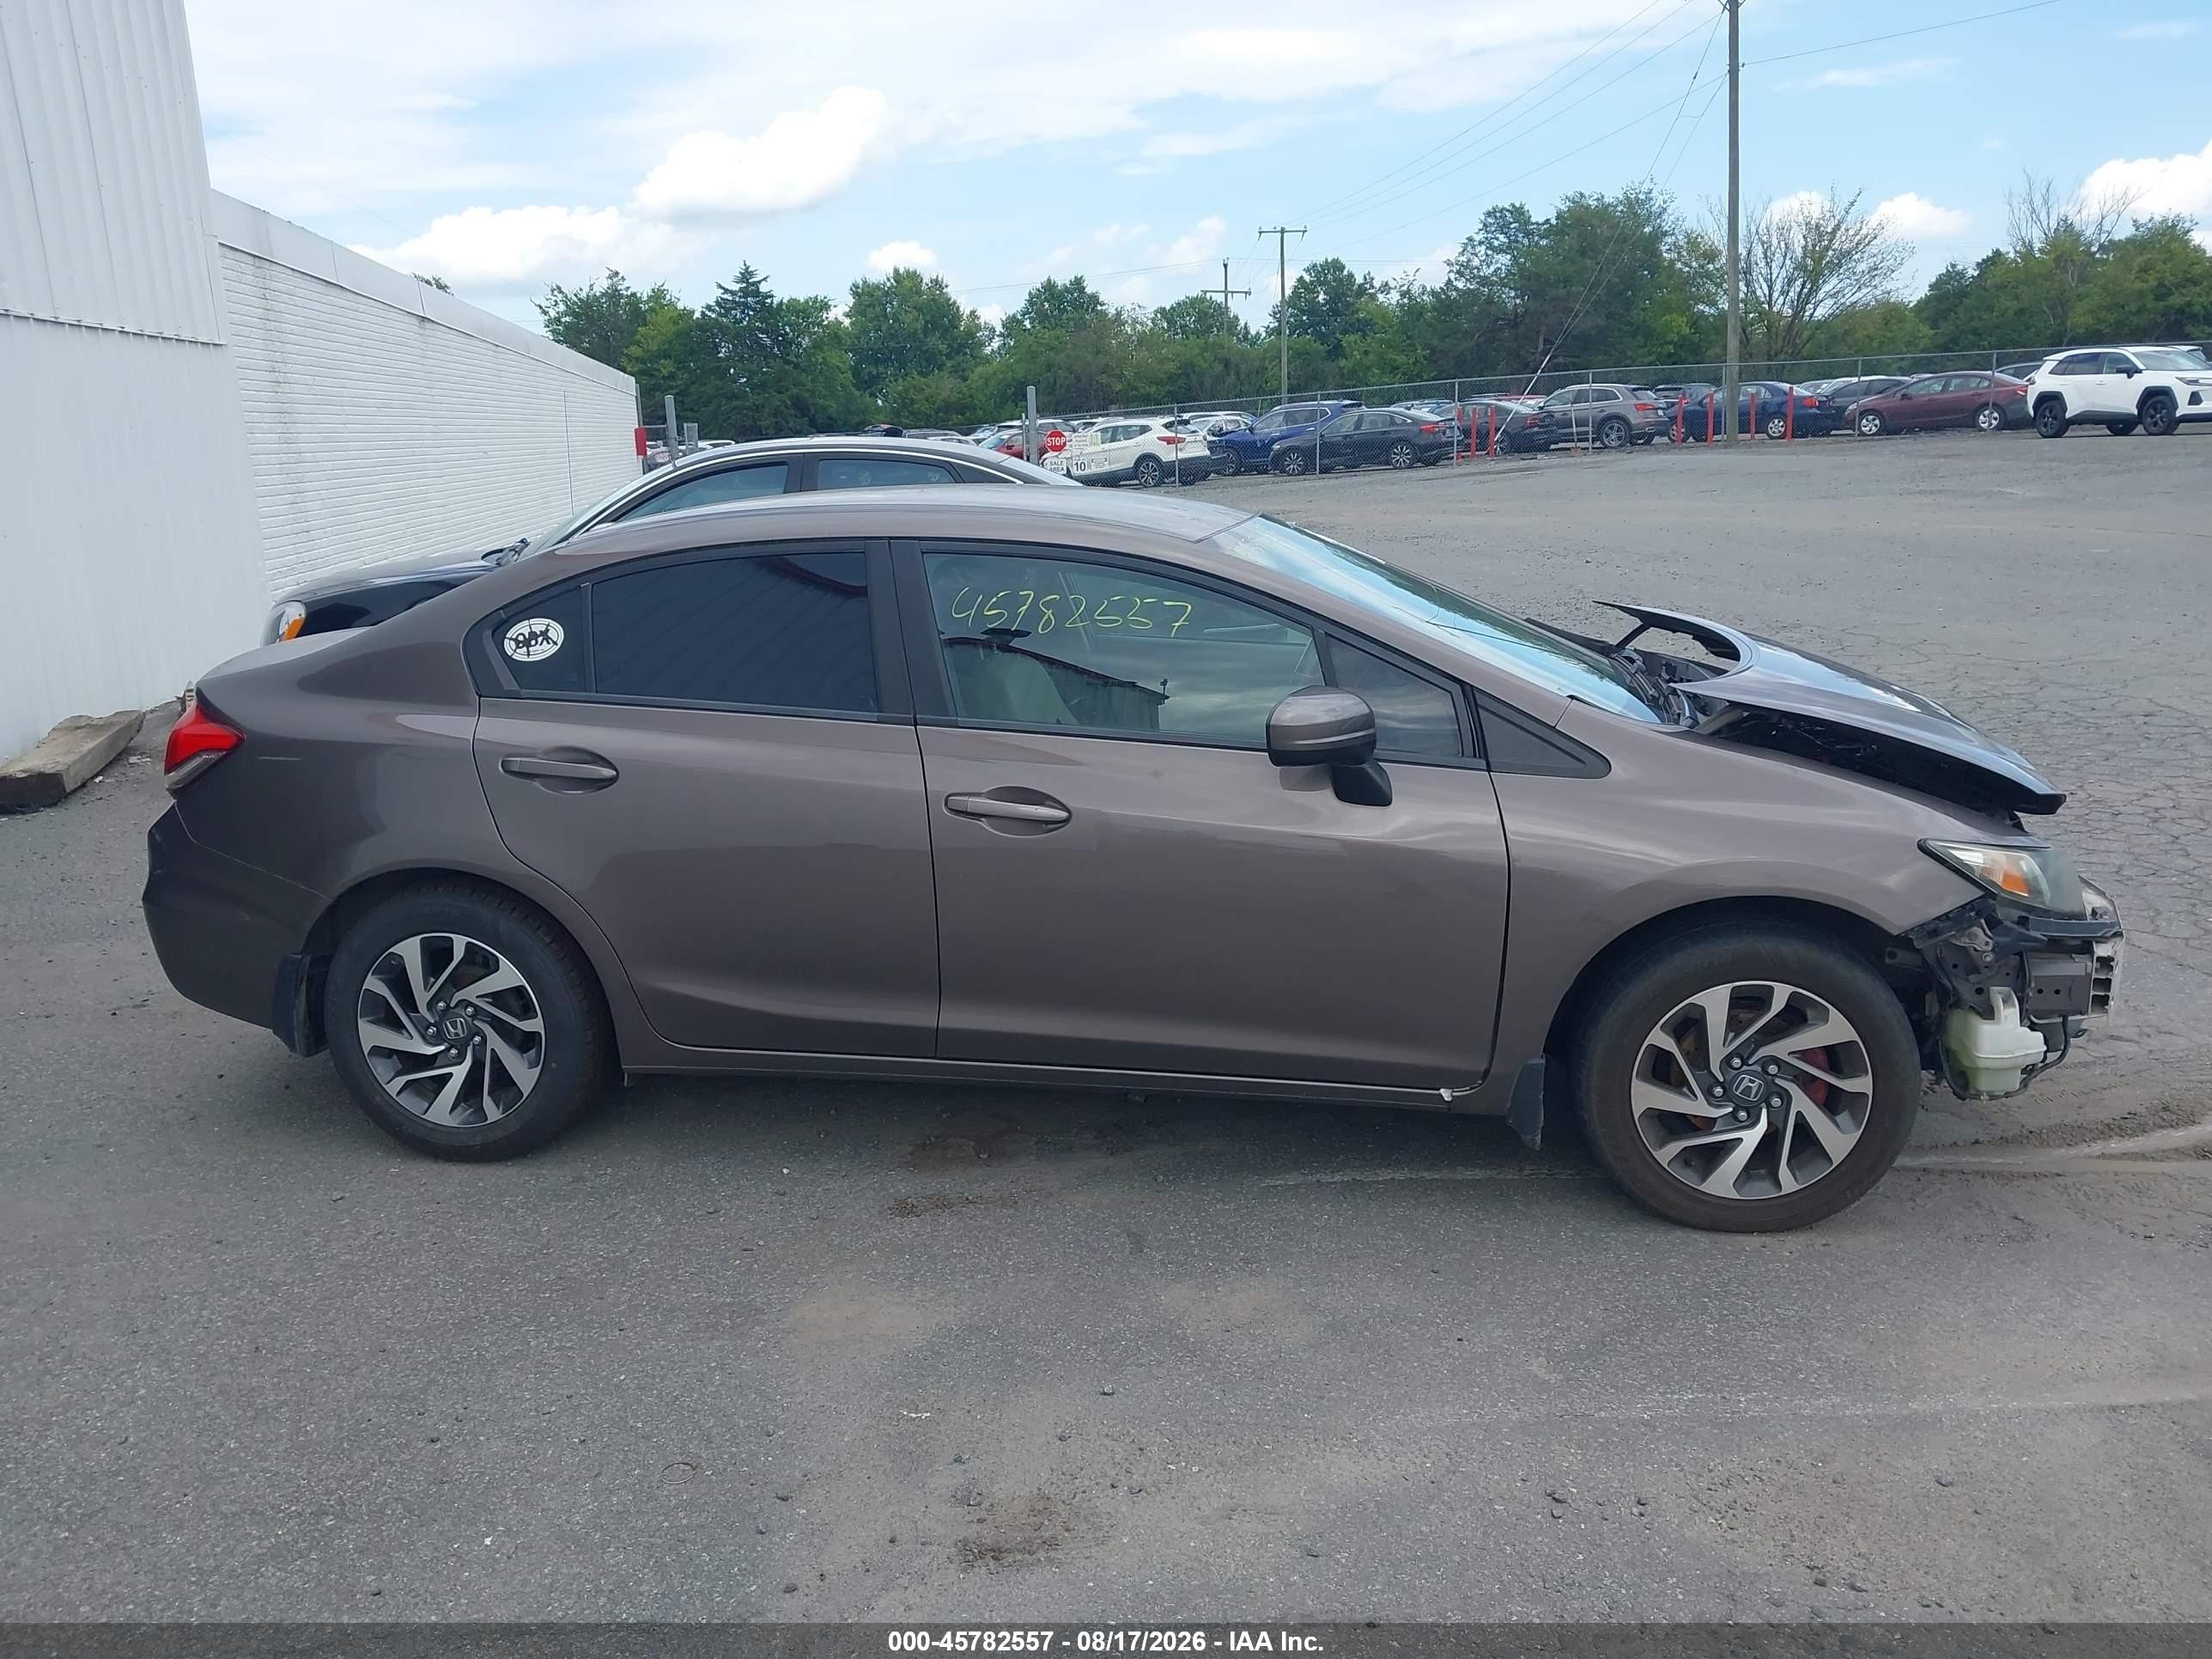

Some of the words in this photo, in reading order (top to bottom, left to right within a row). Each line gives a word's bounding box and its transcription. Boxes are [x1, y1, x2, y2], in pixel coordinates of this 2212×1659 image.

[1047, 436, 1066, 447] STOP
[1073, 461, 1086, 472] 10
[951, 586, 1193, 639] 45782557
